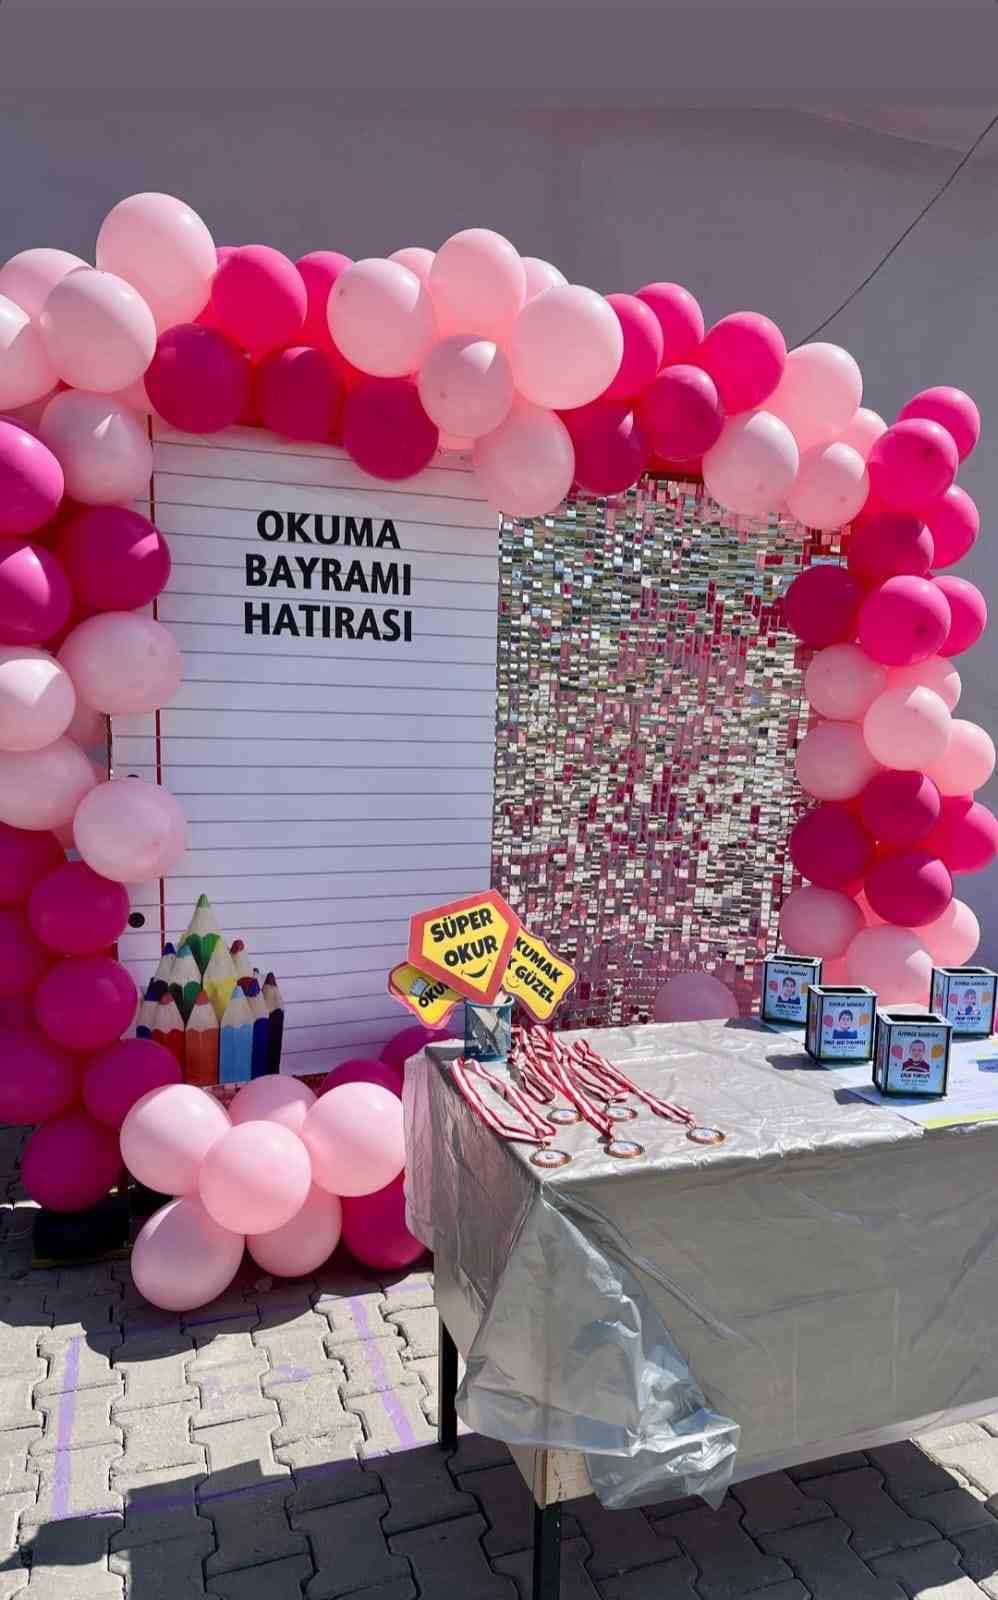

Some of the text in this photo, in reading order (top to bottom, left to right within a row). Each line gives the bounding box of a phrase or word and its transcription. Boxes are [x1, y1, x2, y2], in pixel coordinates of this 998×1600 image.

[256, 510, 401, 549] OKUMA
[245, 553, 411, 595] BAYRAMI
[244, 601, 412, 642] HATIRASI
[430, 908, 493, 943] SÜPER
[444, 935, 498, 967] OKUR
[515, 936, 563, 984] KUMAK
[419, 981, 448, 1008] OKU
[515, 965, 554, 1004] GÜZEL
